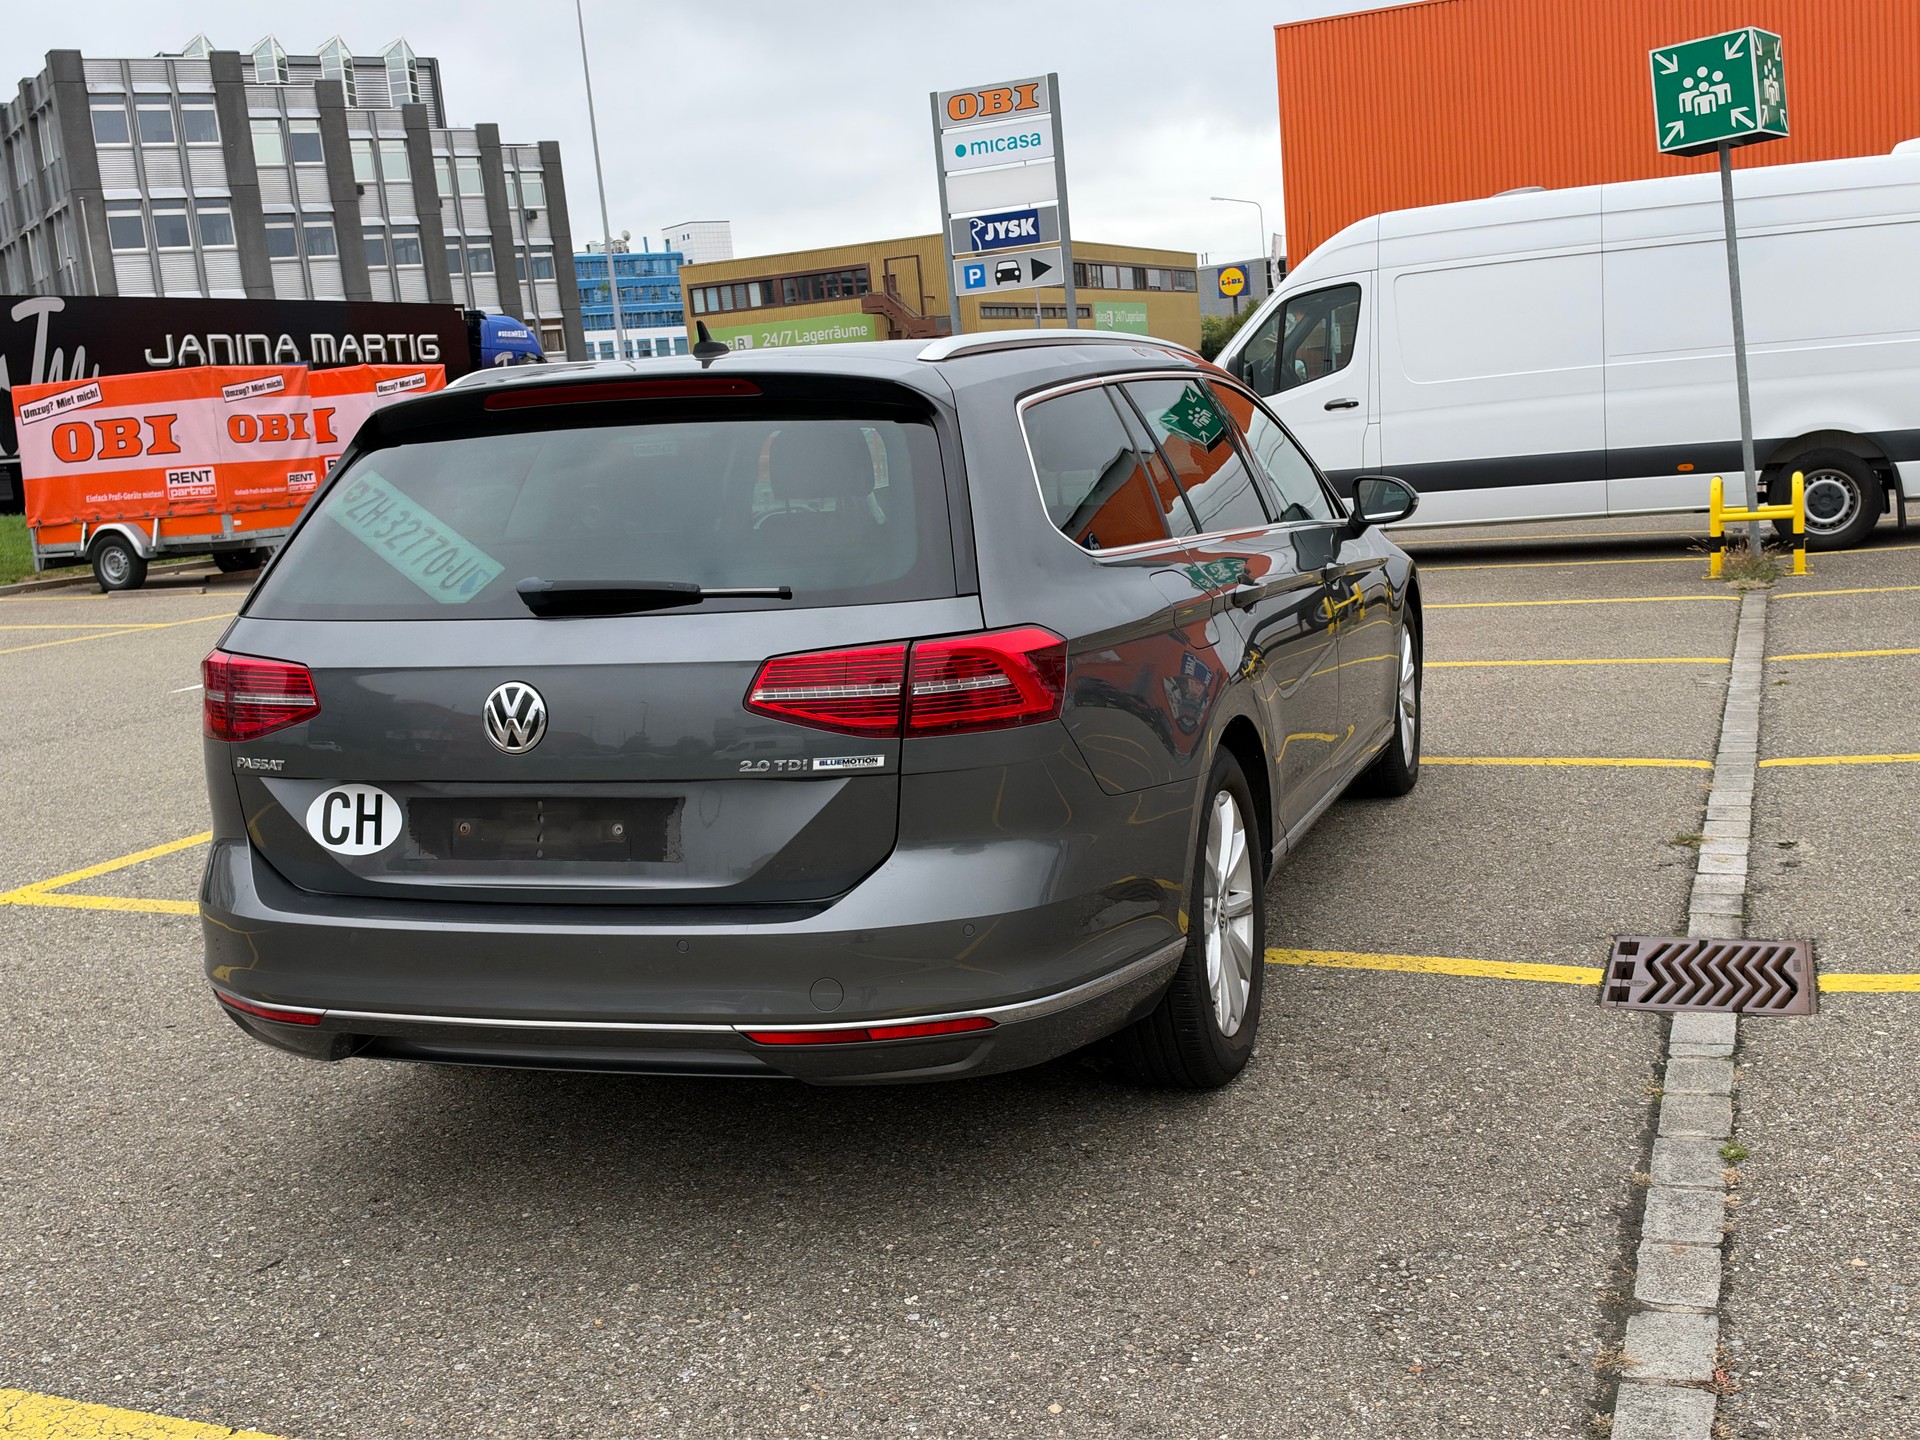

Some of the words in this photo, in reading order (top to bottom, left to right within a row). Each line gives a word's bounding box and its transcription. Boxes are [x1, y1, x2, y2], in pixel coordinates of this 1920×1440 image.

[947, 82, 1040, 121] OBI
[970, 132, 1042, 156] micasa
[985, 217, 1036, 241] JYSK
[969, 268, 982, 285] P
[762, 331, 792, 348] 24/7
[795, 325, 868, 344] Lagerräume
[145, 334, 300, 367] JANINA
[310, 333, 441, 363] MARTIG
[23, 401, 54, 418] Umzug?
[56, 395, 75, 409] Miet
[77, 387, 99, 402] mich!
[52, 413, 181, 463] OBI
[227, 413, 311, 443] OBI
[168, 470, 212, 484] RENT
[289, 473, 313, 482] RENT
[170, 485, 215, 498] partner
[236, 757, 285, 771] PASSAT
[739, 759, 770, 772] 2.0
[774, 758, 808, 771] TDI
[819, 757, 878, 767] BLUEMOTION
[322, 791, 384, 846] CH
